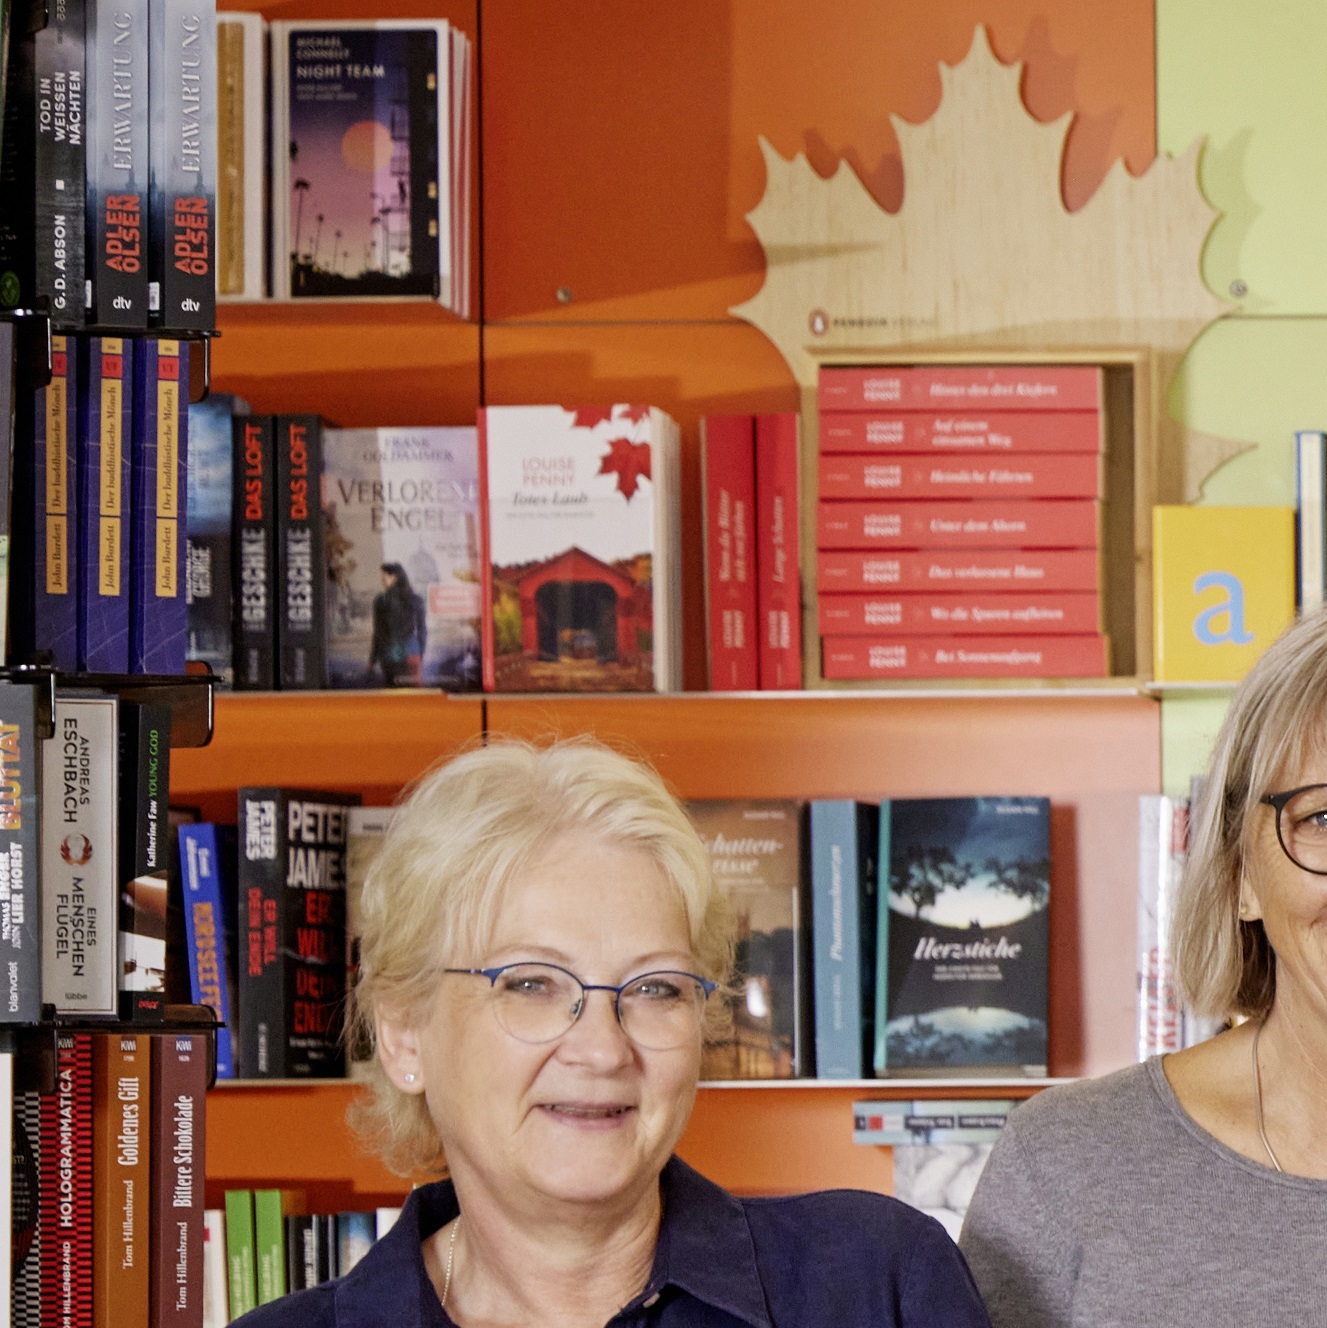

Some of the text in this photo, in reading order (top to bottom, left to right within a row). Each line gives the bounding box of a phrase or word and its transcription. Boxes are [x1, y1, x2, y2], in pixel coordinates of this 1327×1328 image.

[40, 78, 51, 133] TOD IN
[54, 71, 66, 142] WEISSEN
[67, 70, 82, 146] NÄCHTEN
[112, 9, 133, 170] ERWARTUNG
[181, 15, 201, 172] ERWARTUNG
[296, 63, 386, 79] NIGHT TEAM
[54, 214, 66, 269] ABSON
[105, 195, 122, 272] ADLER
[121, 195, 141, 273] OLSEN
[173, 196, 191, 275] ADLER
[189, 197, 209, 276] OLSEN
[112, 295, 132, 311] dtv
[181, 297, 201, 313] dtv
[51, 383, 64, 508] Der buddhistische Mönch
[105, 386, 118, 510] Der buddhistische Mönch
[245, 423, 262, 520] DAS LOFT
[290, 423, 308, 520] DAS LOFT
[521, 455, 576, 471] LOUISE
[521, 472, 576, 488] PENNY
[52, 523, 64, 588] John Burdett
[104, 525, 116, 589] John Burdett
[242, 528, 267, 622] GESCHKE
[287, 528, 313, 622] GESCHKE
[1192, 569, 1255, 647] a
[0, 723, 21, 830] BLUTTAT
[63, 717, 78, 823] ESCHBACH
[79, 735, 91, 806] ANDREAS
[146, 729, 160, 868] Katherine Faw YOUNG GOD
[2, 901, 11, 940] THOMAS
[56, 893, 72, 960] FLÜGEL
[71, 876, 85, 977] MENSCHEN
[86, 907, 97, 947] EINES
[913, 936, 1023, 962] Herzstiche
[8, 961, 19, 1012] blanvalet
[59, 1068, 74, 1229] HOLOGRAMMATICA
[117, 1076, 139, 1167] Goldenes Gift
[172, 1094, 193, 1209] Bittere Schokolade
[122, 1179, 134, 1270] Tom Hillenbrand
[62, 1240, 73, 1315] HILLENBRAND
[176, 1221, 188, 1312] Tom Hillenbrand
